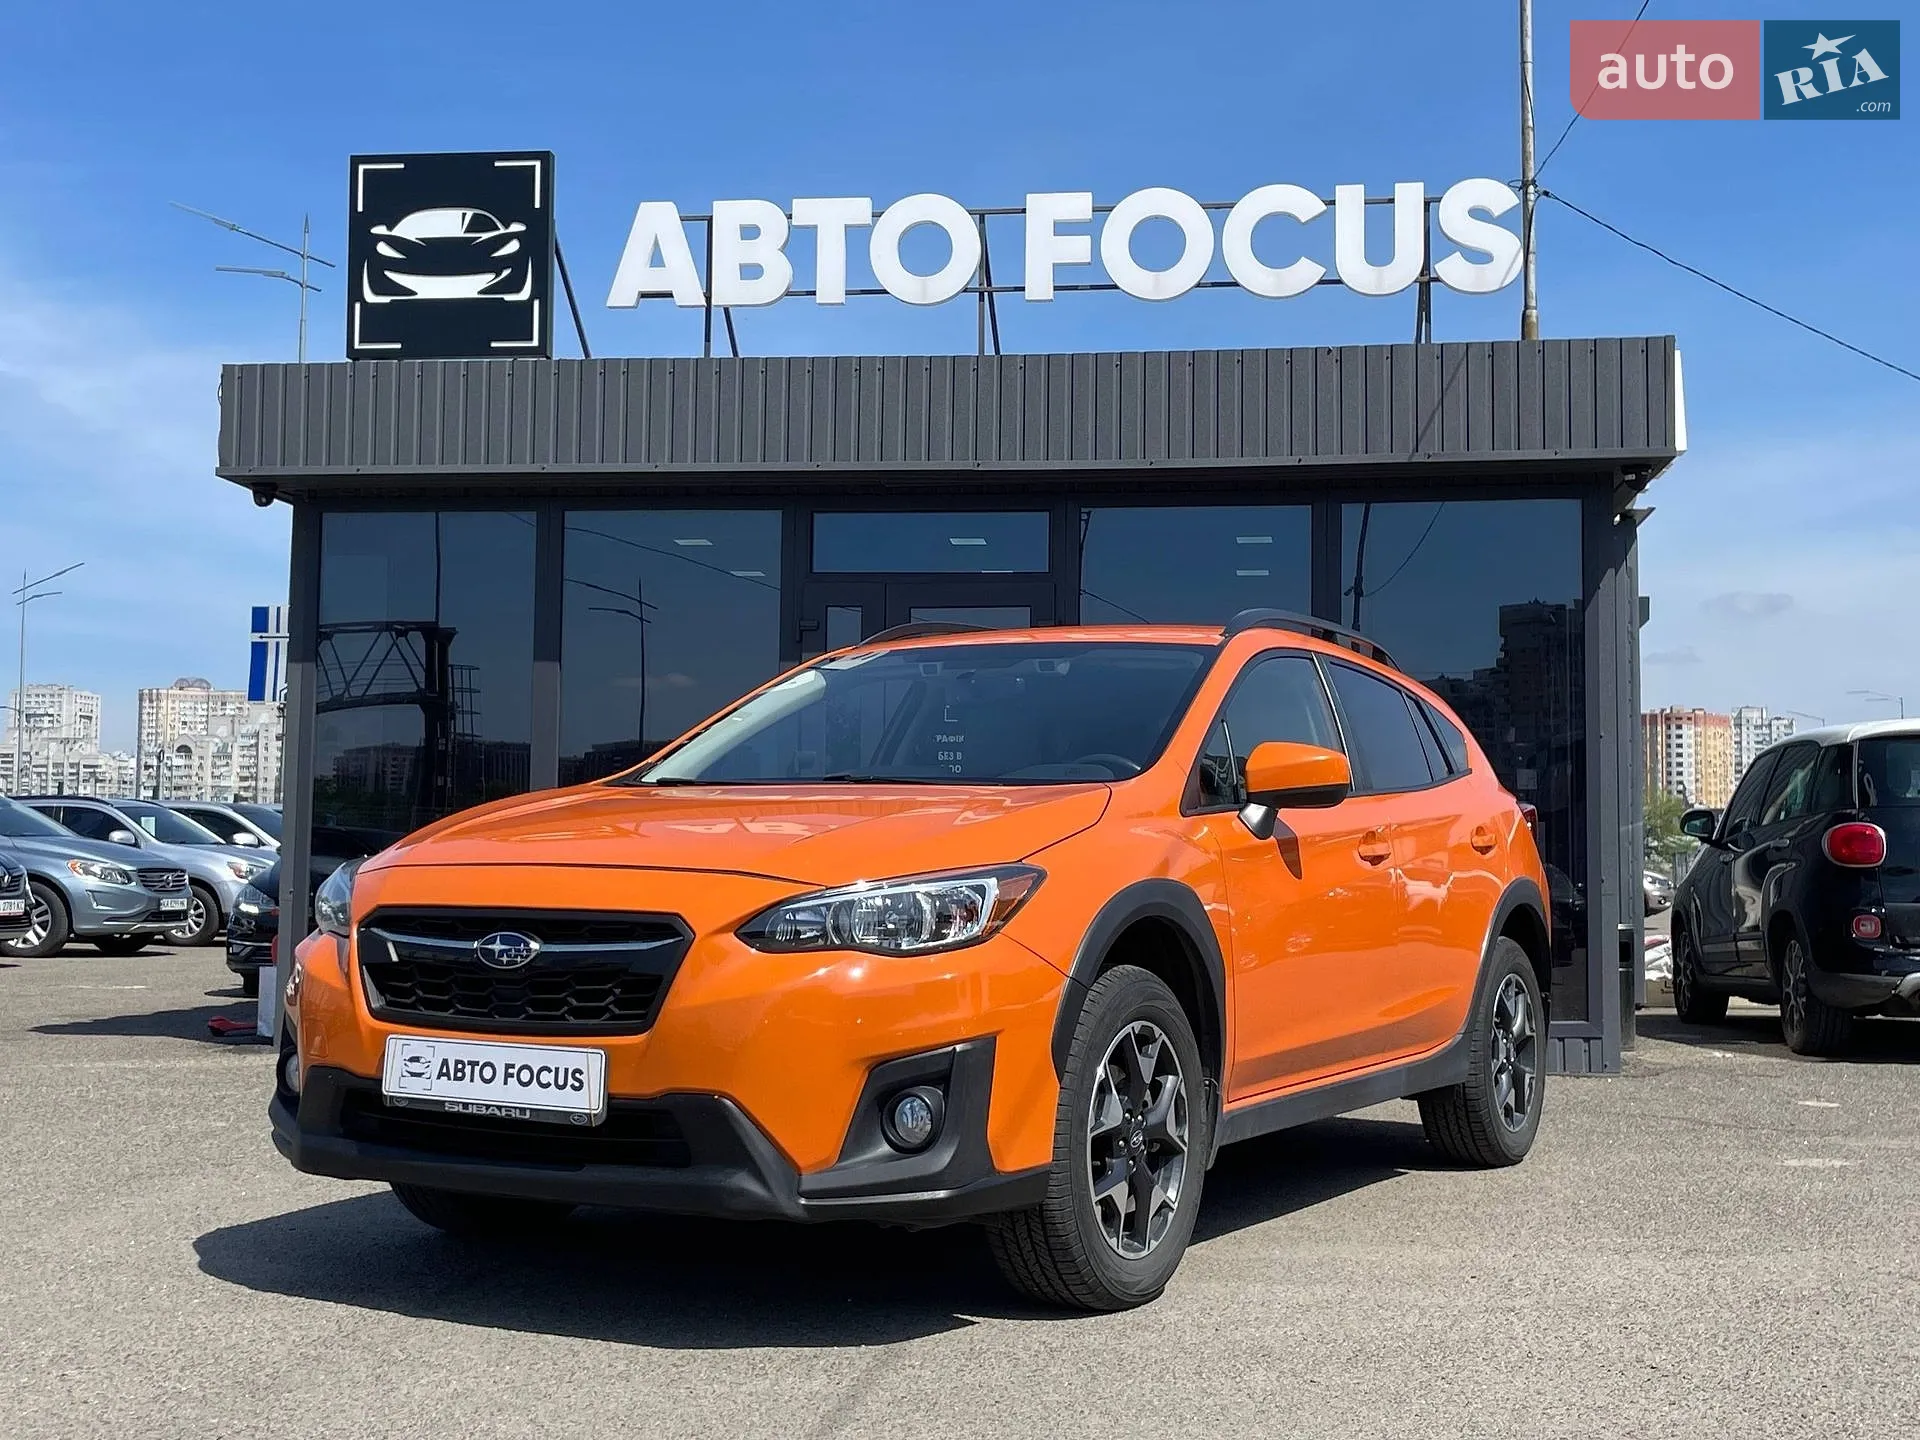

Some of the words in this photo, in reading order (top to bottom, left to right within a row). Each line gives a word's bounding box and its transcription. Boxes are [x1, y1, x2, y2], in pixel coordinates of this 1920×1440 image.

[606, 193, 983, 308] АВТО
[1025, 177, 1525, 302] FOCUS
[933, 734, 965, 743] РАФІК
[436, 1058, 497, 1084] АВТО
[503, 1062, 585, 1092] FOCUS
[444, 1101, 531, 1119] SUBARU
